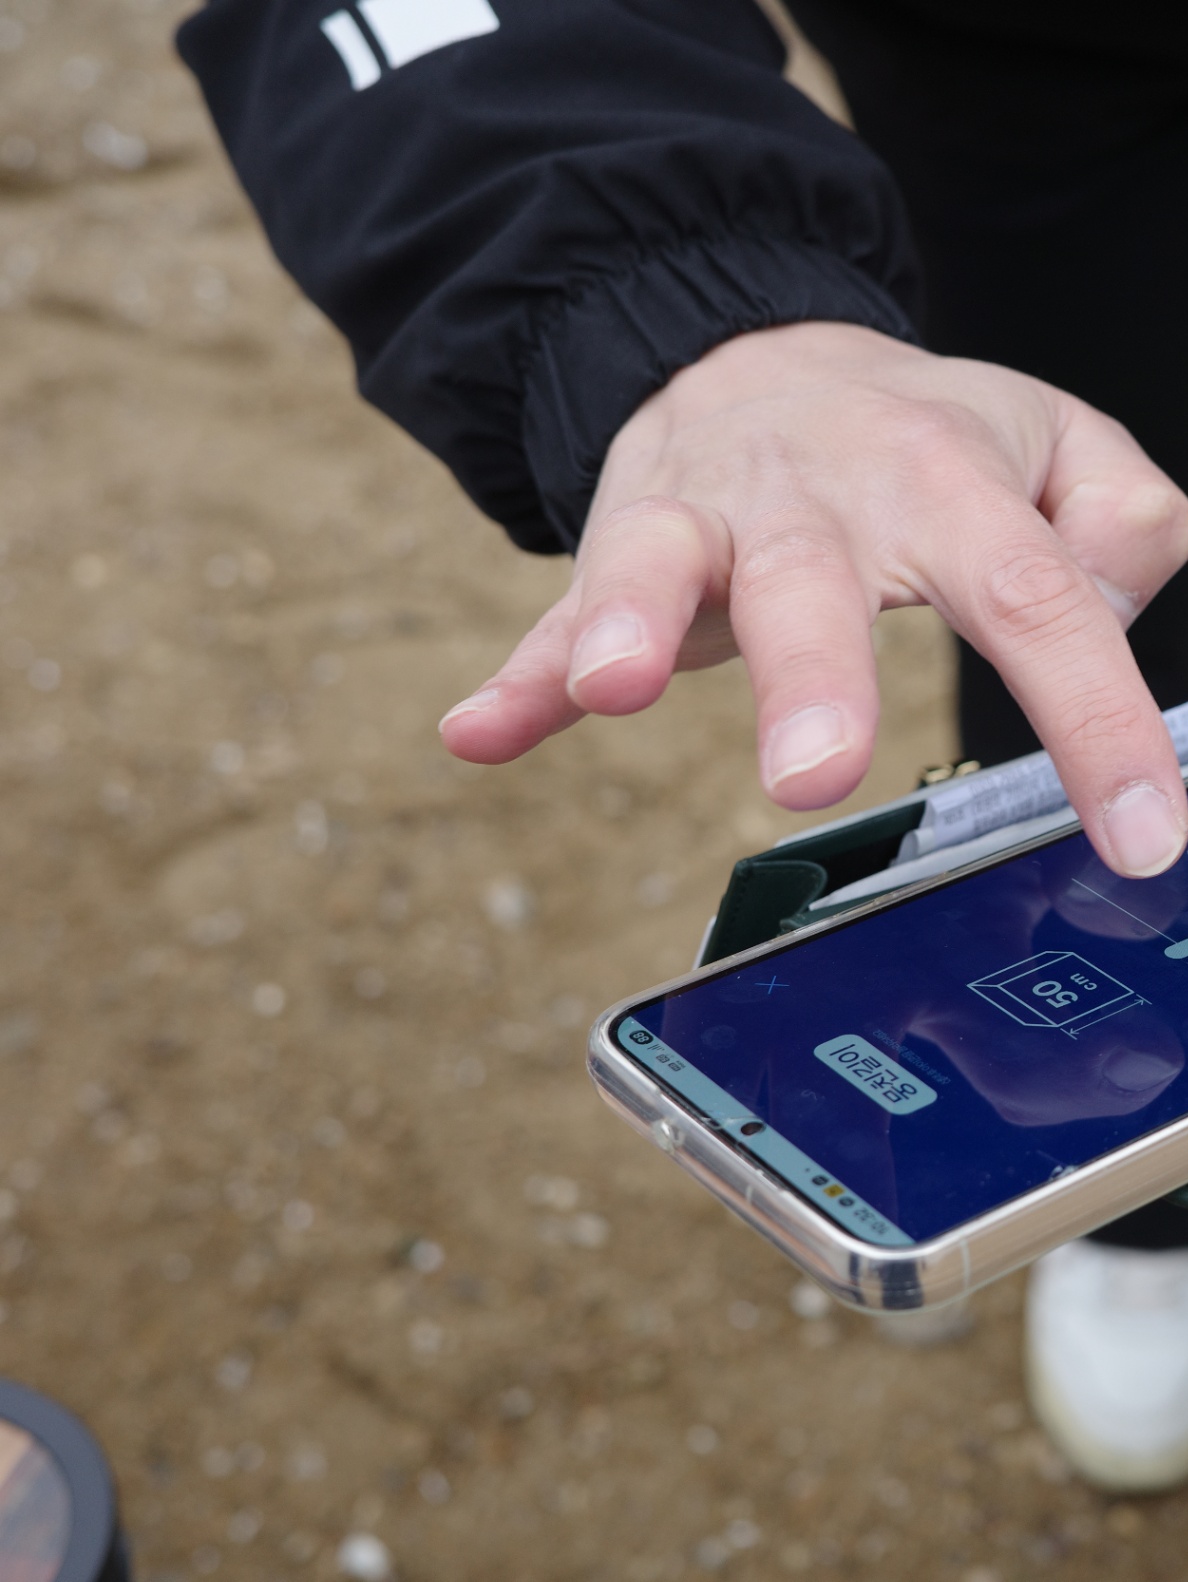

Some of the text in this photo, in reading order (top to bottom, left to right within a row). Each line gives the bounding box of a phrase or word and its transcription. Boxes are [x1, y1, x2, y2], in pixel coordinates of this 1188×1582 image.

[1070, 973, 1096, 990] cm
[1032, 981, 1078, 1008] 50
[632, 1031, 650, 1043] 88
[829, 1043, 918, 1103] 뭉친길이
